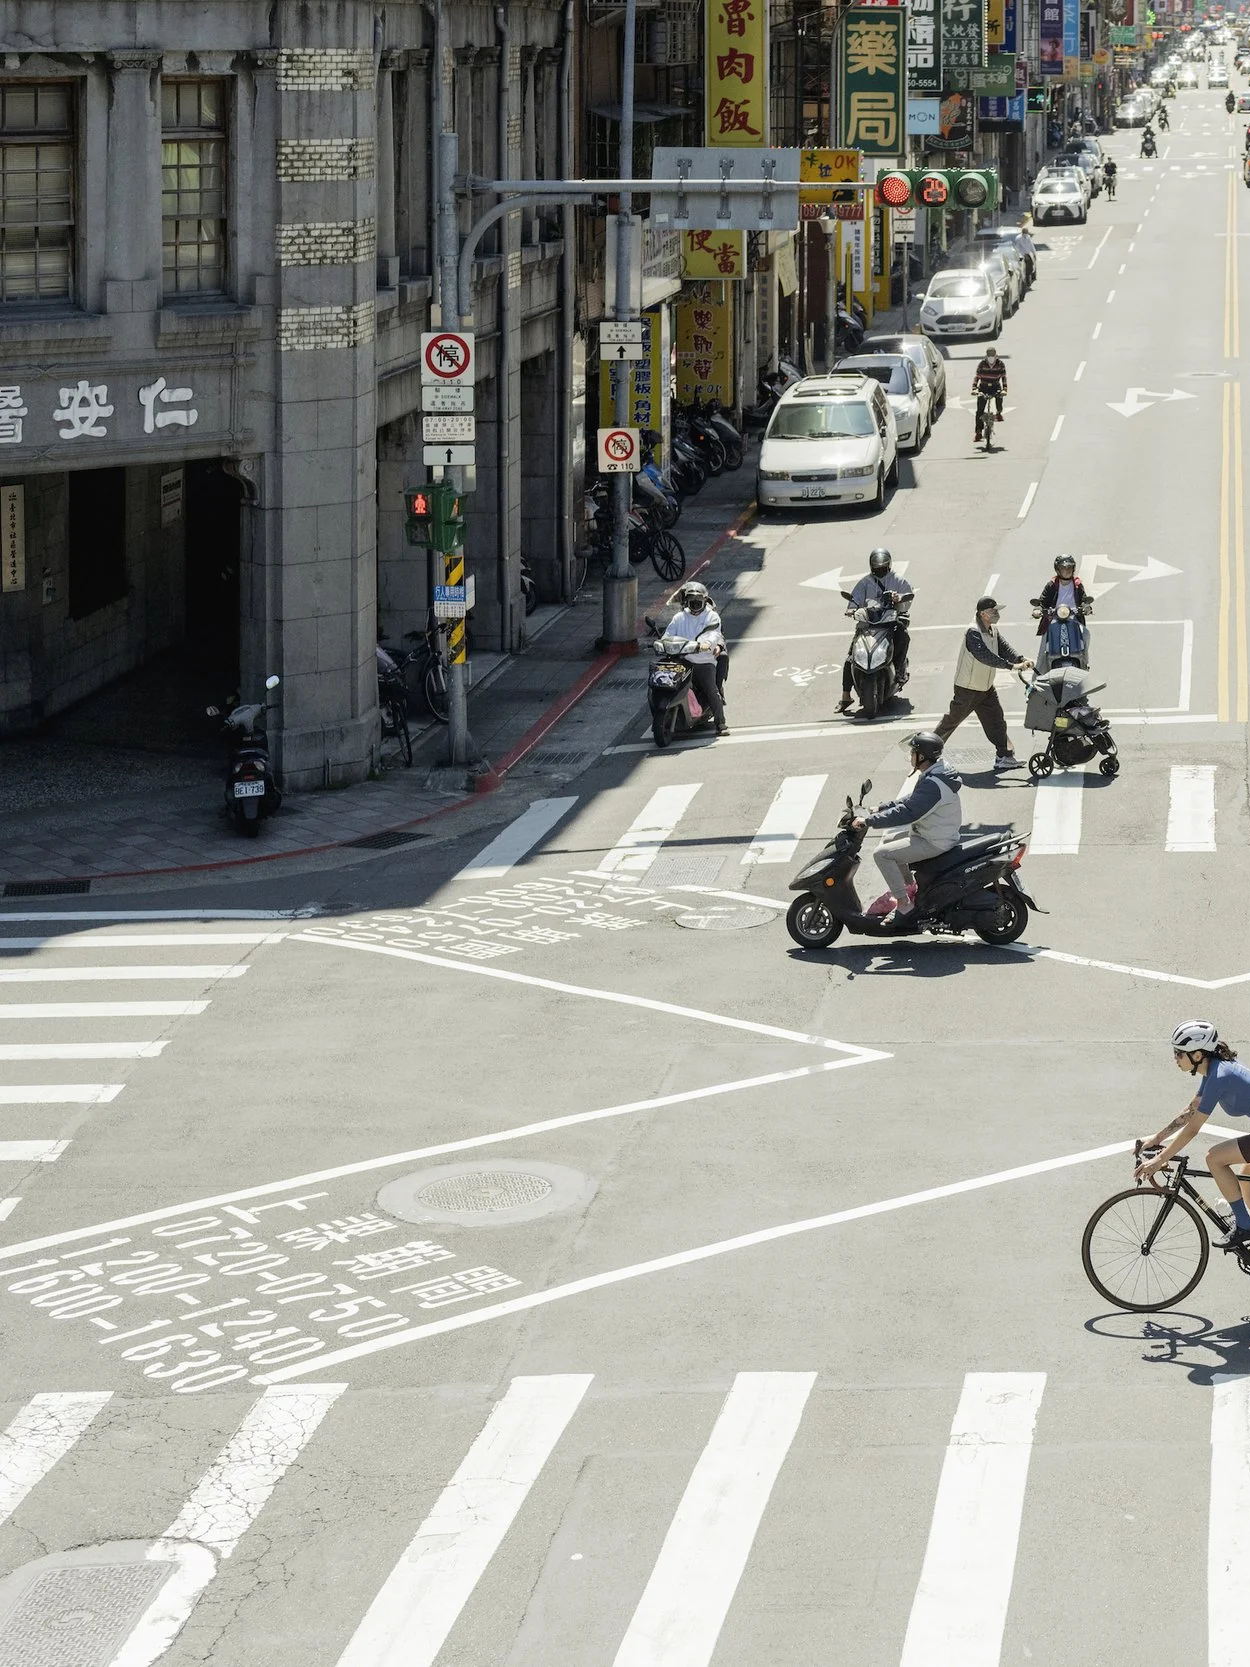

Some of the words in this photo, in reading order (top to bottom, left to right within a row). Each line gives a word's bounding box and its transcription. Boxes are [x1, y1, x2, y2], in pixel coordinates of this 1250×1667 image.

[713, 0, 761, 136] 魯肉飯
[846, 20, 898, 147] 藥局
[908, 0, 935, 68] 精品
[686, 230, 740, 274] 便當
[436, 344, 459, 368] 停
[61, 1237, 325, 1365] 1200-1240
[151, 1216, 410, 1337] 0720-0750
[222, 1191, 523, 1309] 上課期間
[0, 1258, 249, 1393] 1600-1630
